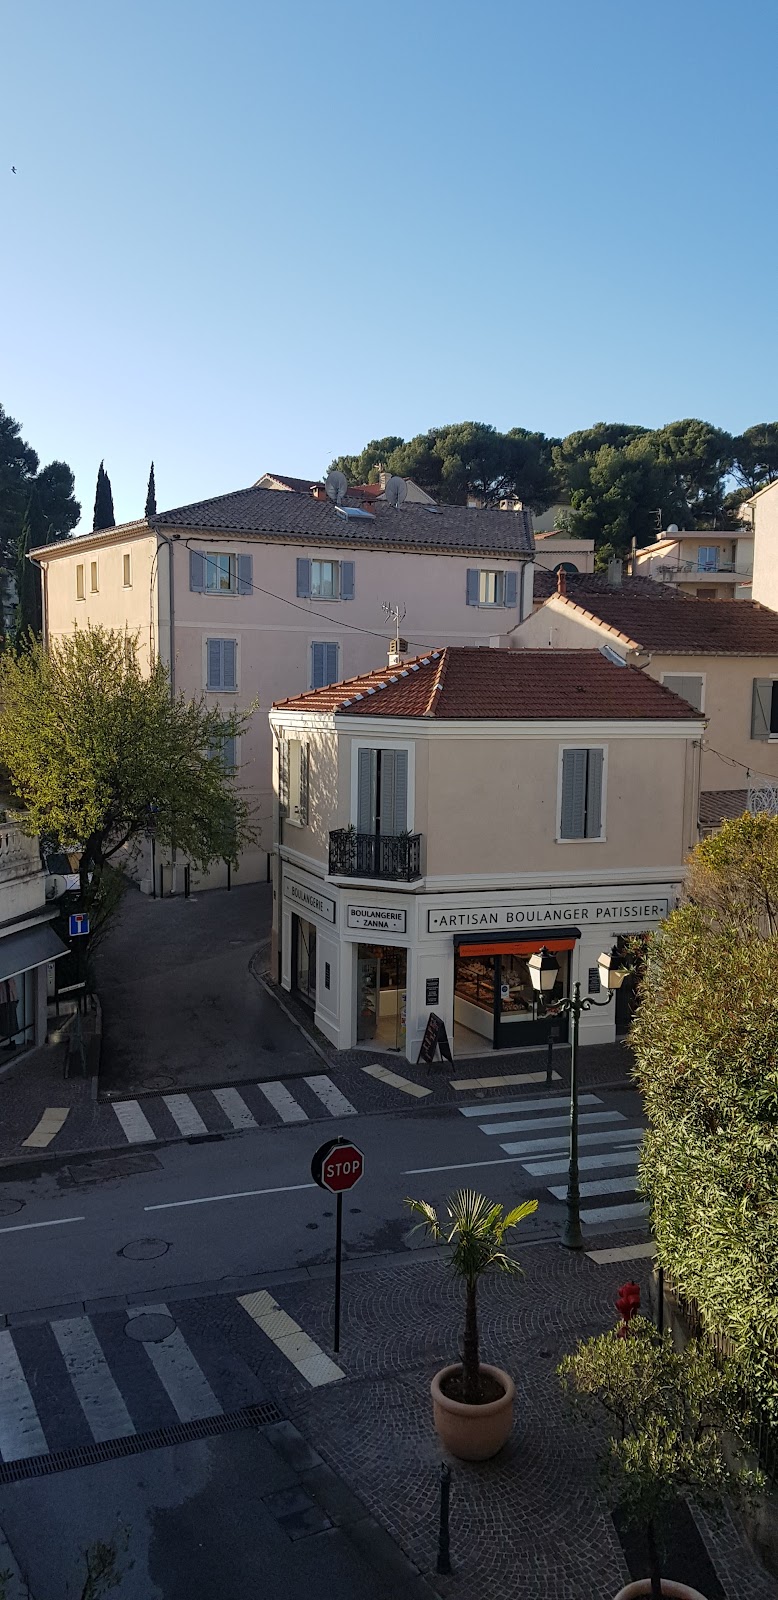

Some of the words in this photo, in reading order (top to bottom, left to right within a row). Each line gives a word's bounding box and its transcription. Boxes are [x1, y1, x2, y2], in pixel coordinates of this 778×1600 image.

[291, 886, 324, 912] BOULANGERIE
[350, 909, 402, 920] BOULANGERIE
[363, 919, 389, 928] ZANNA
[439, 913, 498, 926] ARTISAN
[506, 908, 589, 923] BOULANGER
[596, 905, 658, 919] PATISSIER
[326, 1160, 360, 1178] STOP
